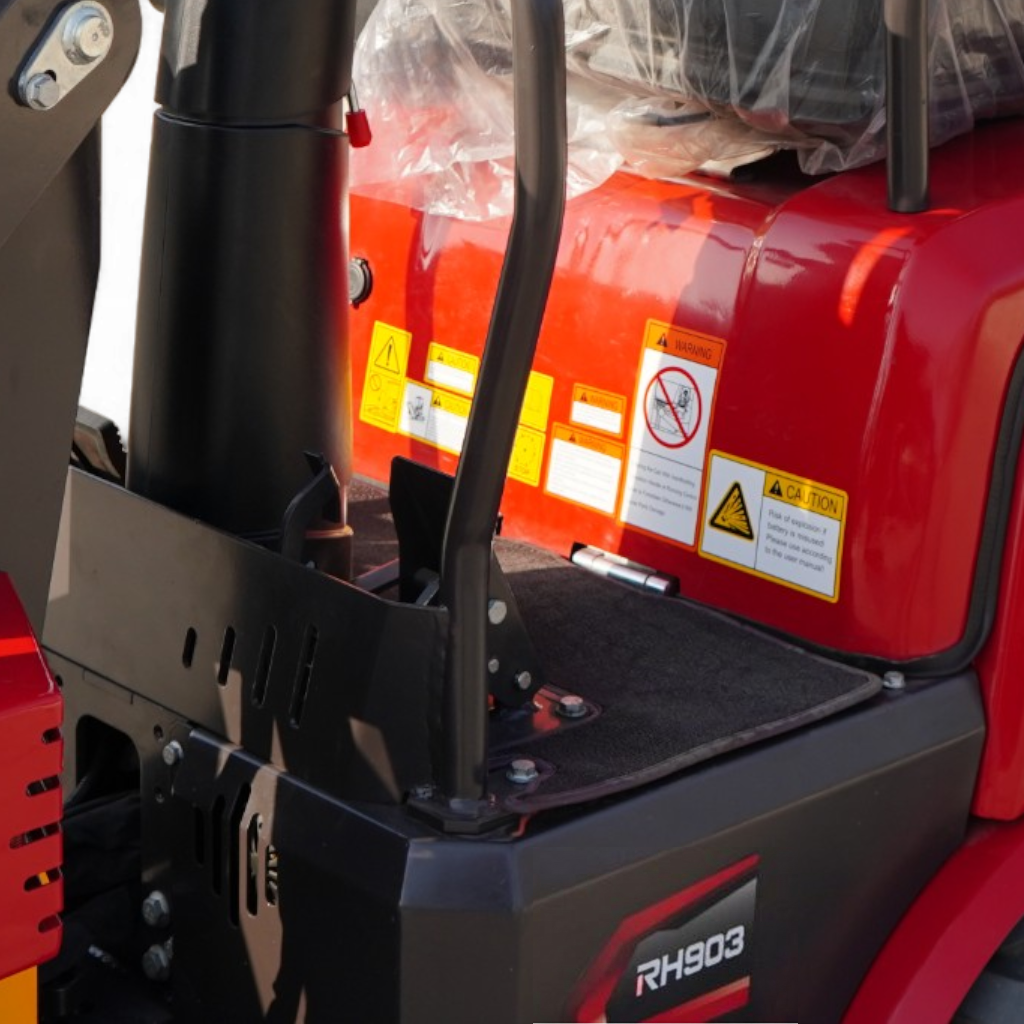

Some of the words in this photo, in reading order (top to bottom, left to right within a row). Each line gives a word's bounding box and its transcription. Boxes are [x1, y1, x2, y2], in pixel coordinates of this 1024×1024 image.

[675, 340, 712, 361] WARNING
[786, 484, 839, 514] CAUTION
[635, 925, 745, 997] RH903
